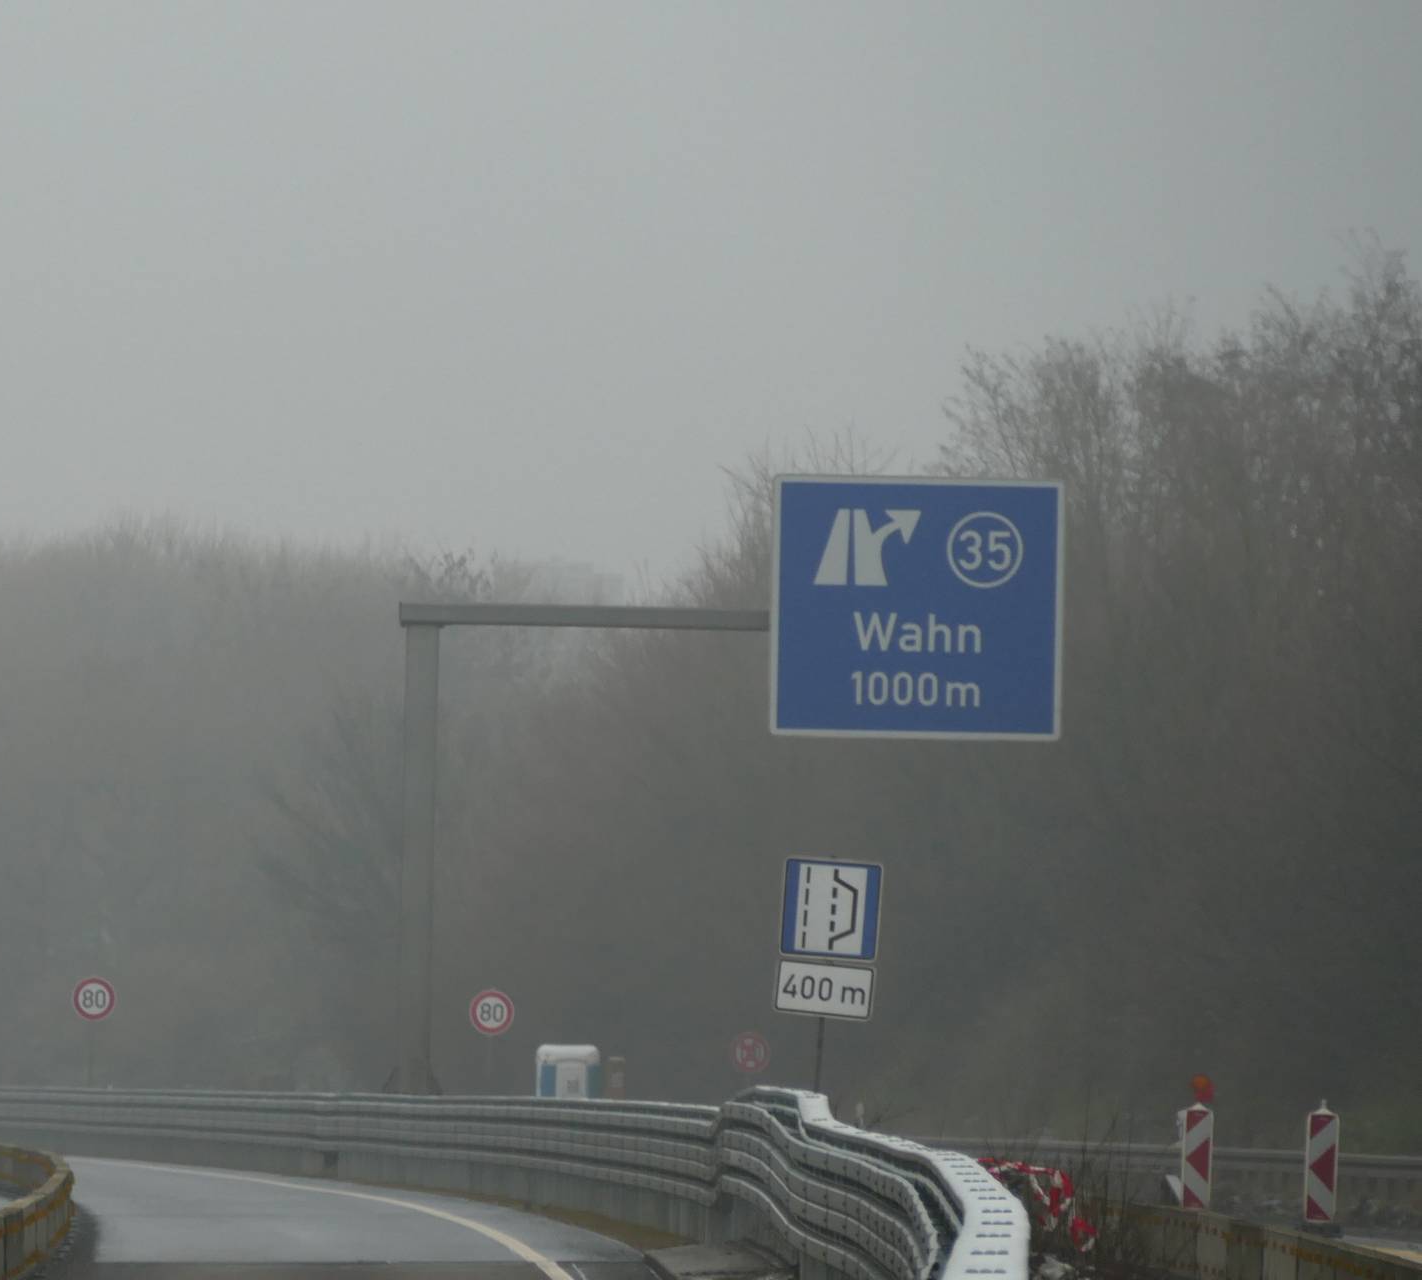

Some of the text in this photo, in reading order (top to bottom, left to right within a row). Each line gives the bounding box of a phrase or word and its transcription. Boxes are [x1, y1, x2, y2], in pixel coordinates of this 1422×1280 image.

[958, 531, 1011, 571] 35
[853, 611, 982, 655] Wahn
[82, 988, 106, 1009] 80
[782, 974, 866, 1006] 400 m
[480, 1002, 504, 1023] 80
